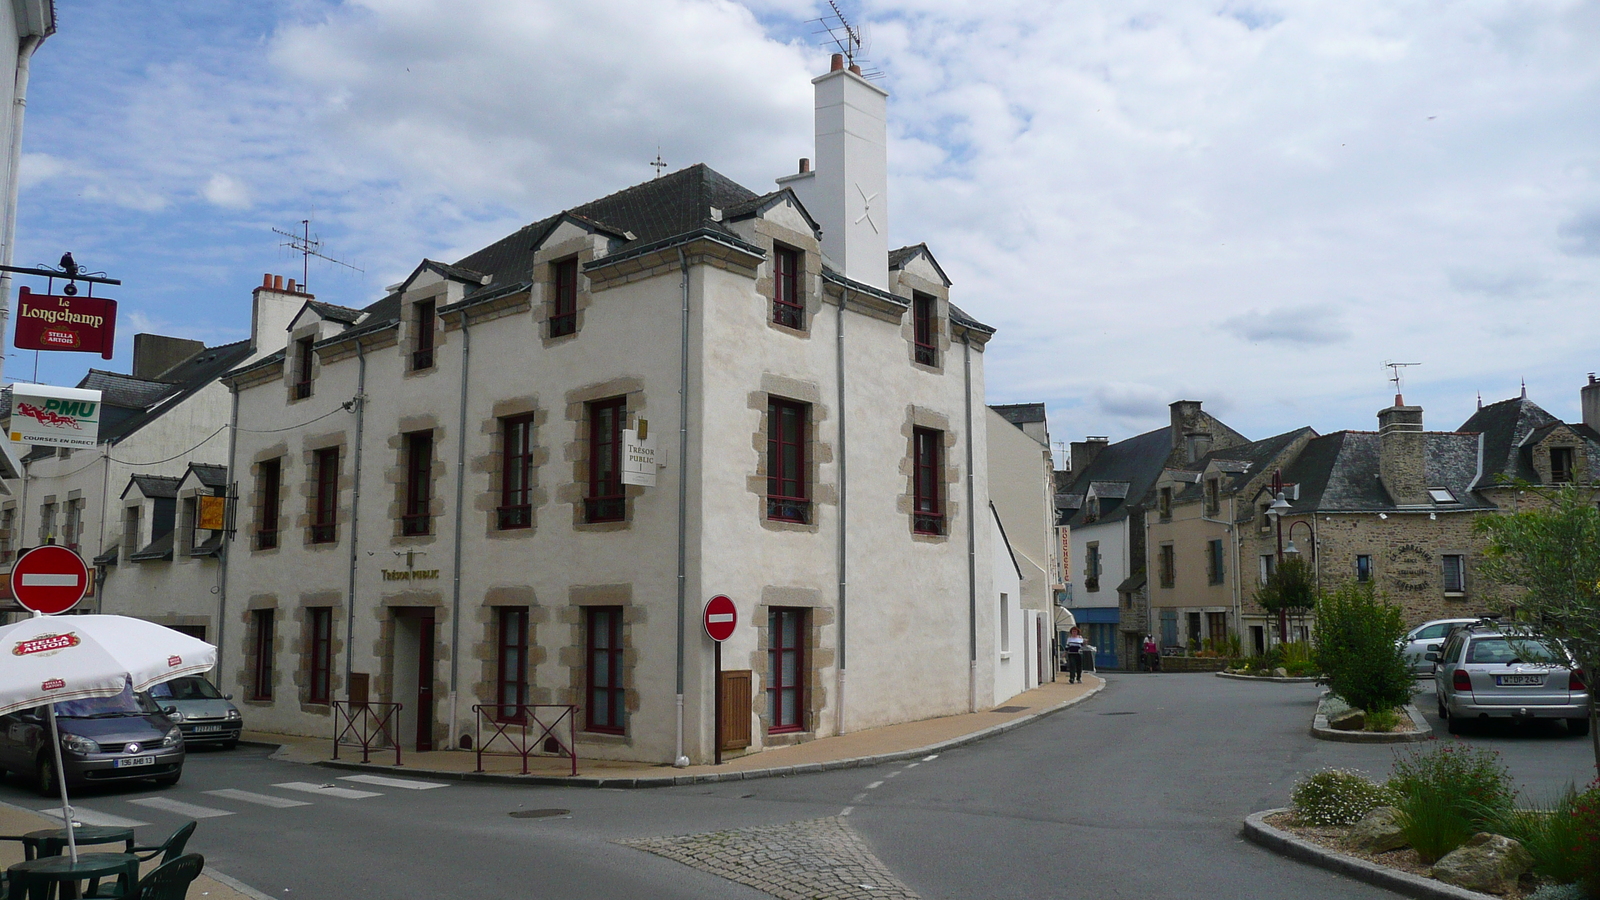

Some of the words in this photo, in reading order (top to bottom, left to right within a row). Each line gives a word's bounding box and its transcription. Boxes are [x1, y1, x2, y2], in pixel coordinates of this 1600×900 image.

[59, 297, 70, 307] Le
[21, 303, 103, 328] Longchamp
[48, 331, 73, 339] STELLA
[45, 399, 96, 418] PMU
[23, 435, 58, 443] COURSES
[629, 455, 654, 464] PUBLIC
[412, 569, 439, 580] PUBLIC
[23, 636, 69, 648] STELLA
[23, 641, 70, 652] ARTOIS
